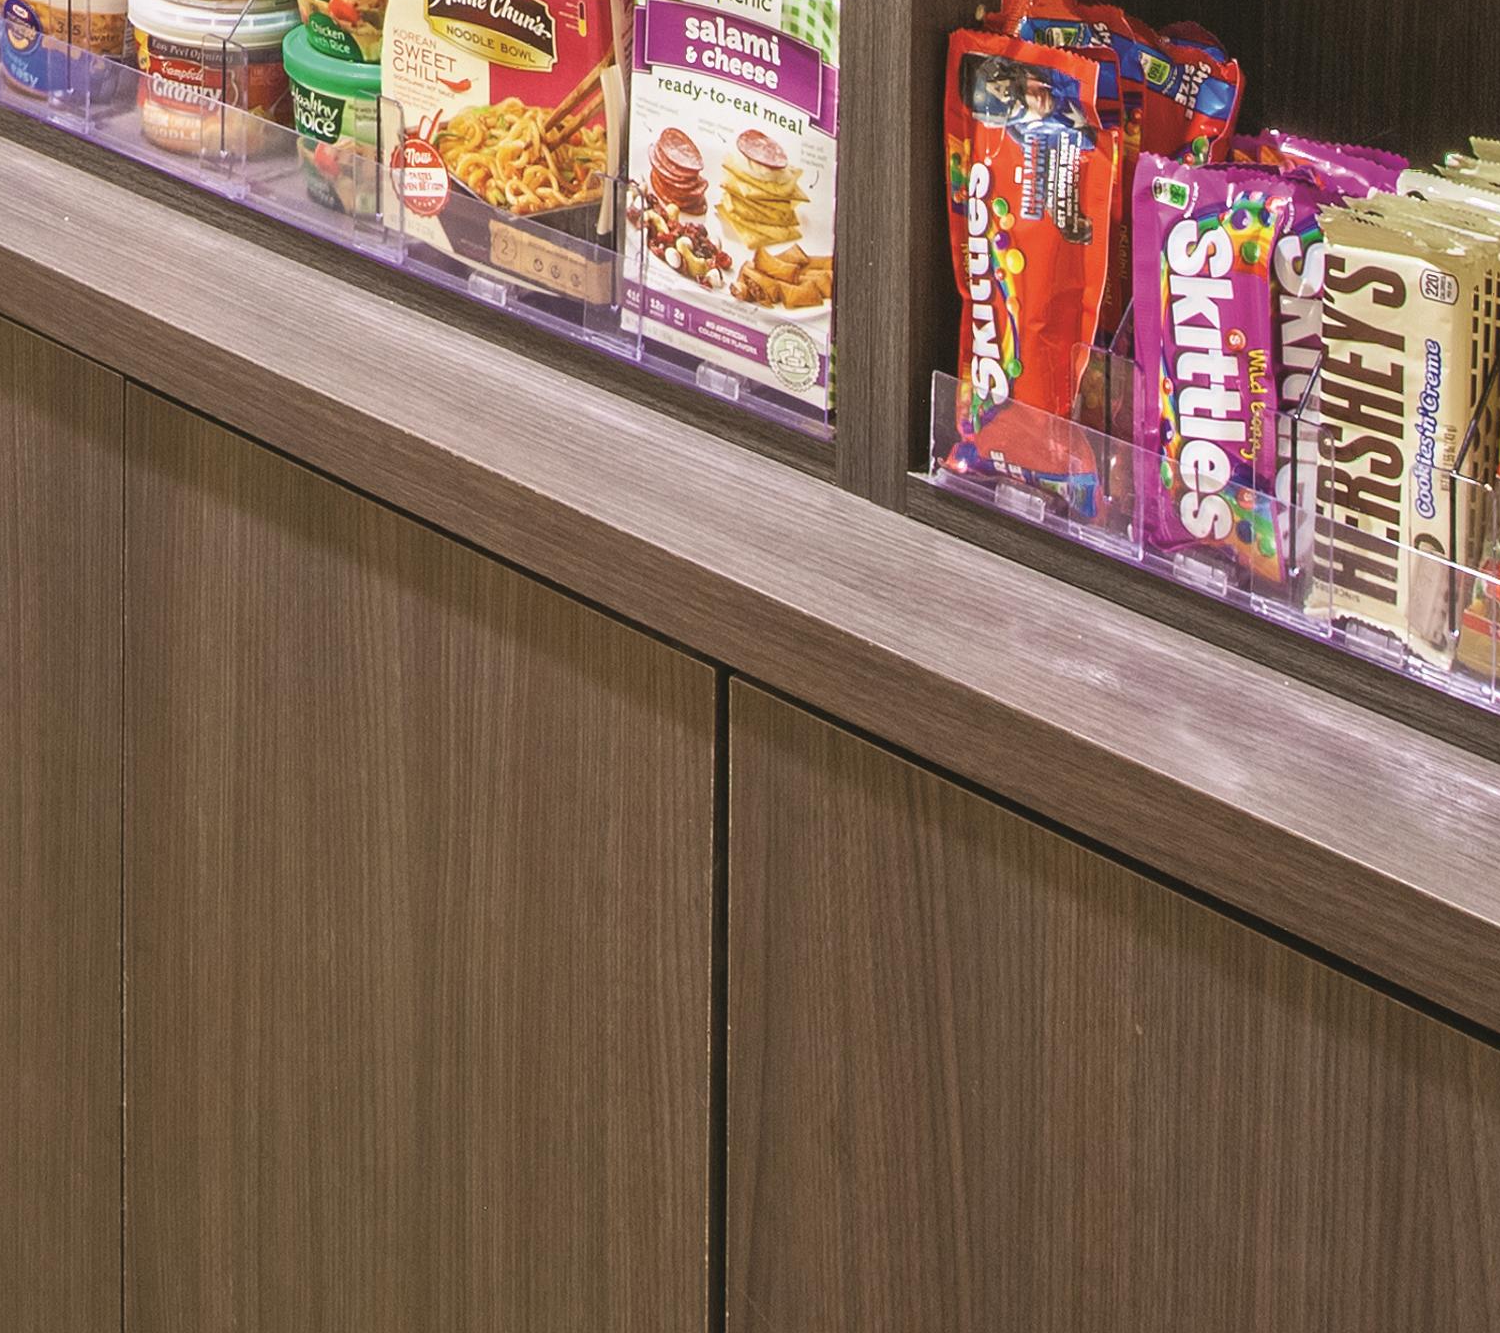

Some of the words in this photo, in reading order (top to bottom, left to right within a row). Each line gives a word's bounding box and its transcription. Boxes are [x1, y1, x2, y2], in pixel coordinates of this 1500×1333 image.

[310, 19, 345, 40] Chicken
[392, 28, 437, 50] KOREAN
[446, 24, 495, 49] NOODLE
[500, 42, 535, 63] BOWL
[685, 14, 782, 67] salami
[392, 39, 457, 73] SWEET
[700, 45, 780, 90] cheese
[658, 75, 759, 117] ready-to-eat
[762, 106, 804, 137] meal
[1165, 218, 1241, 542] Skittles
[1314, 253, 1407, 605] HERSHEY'S
